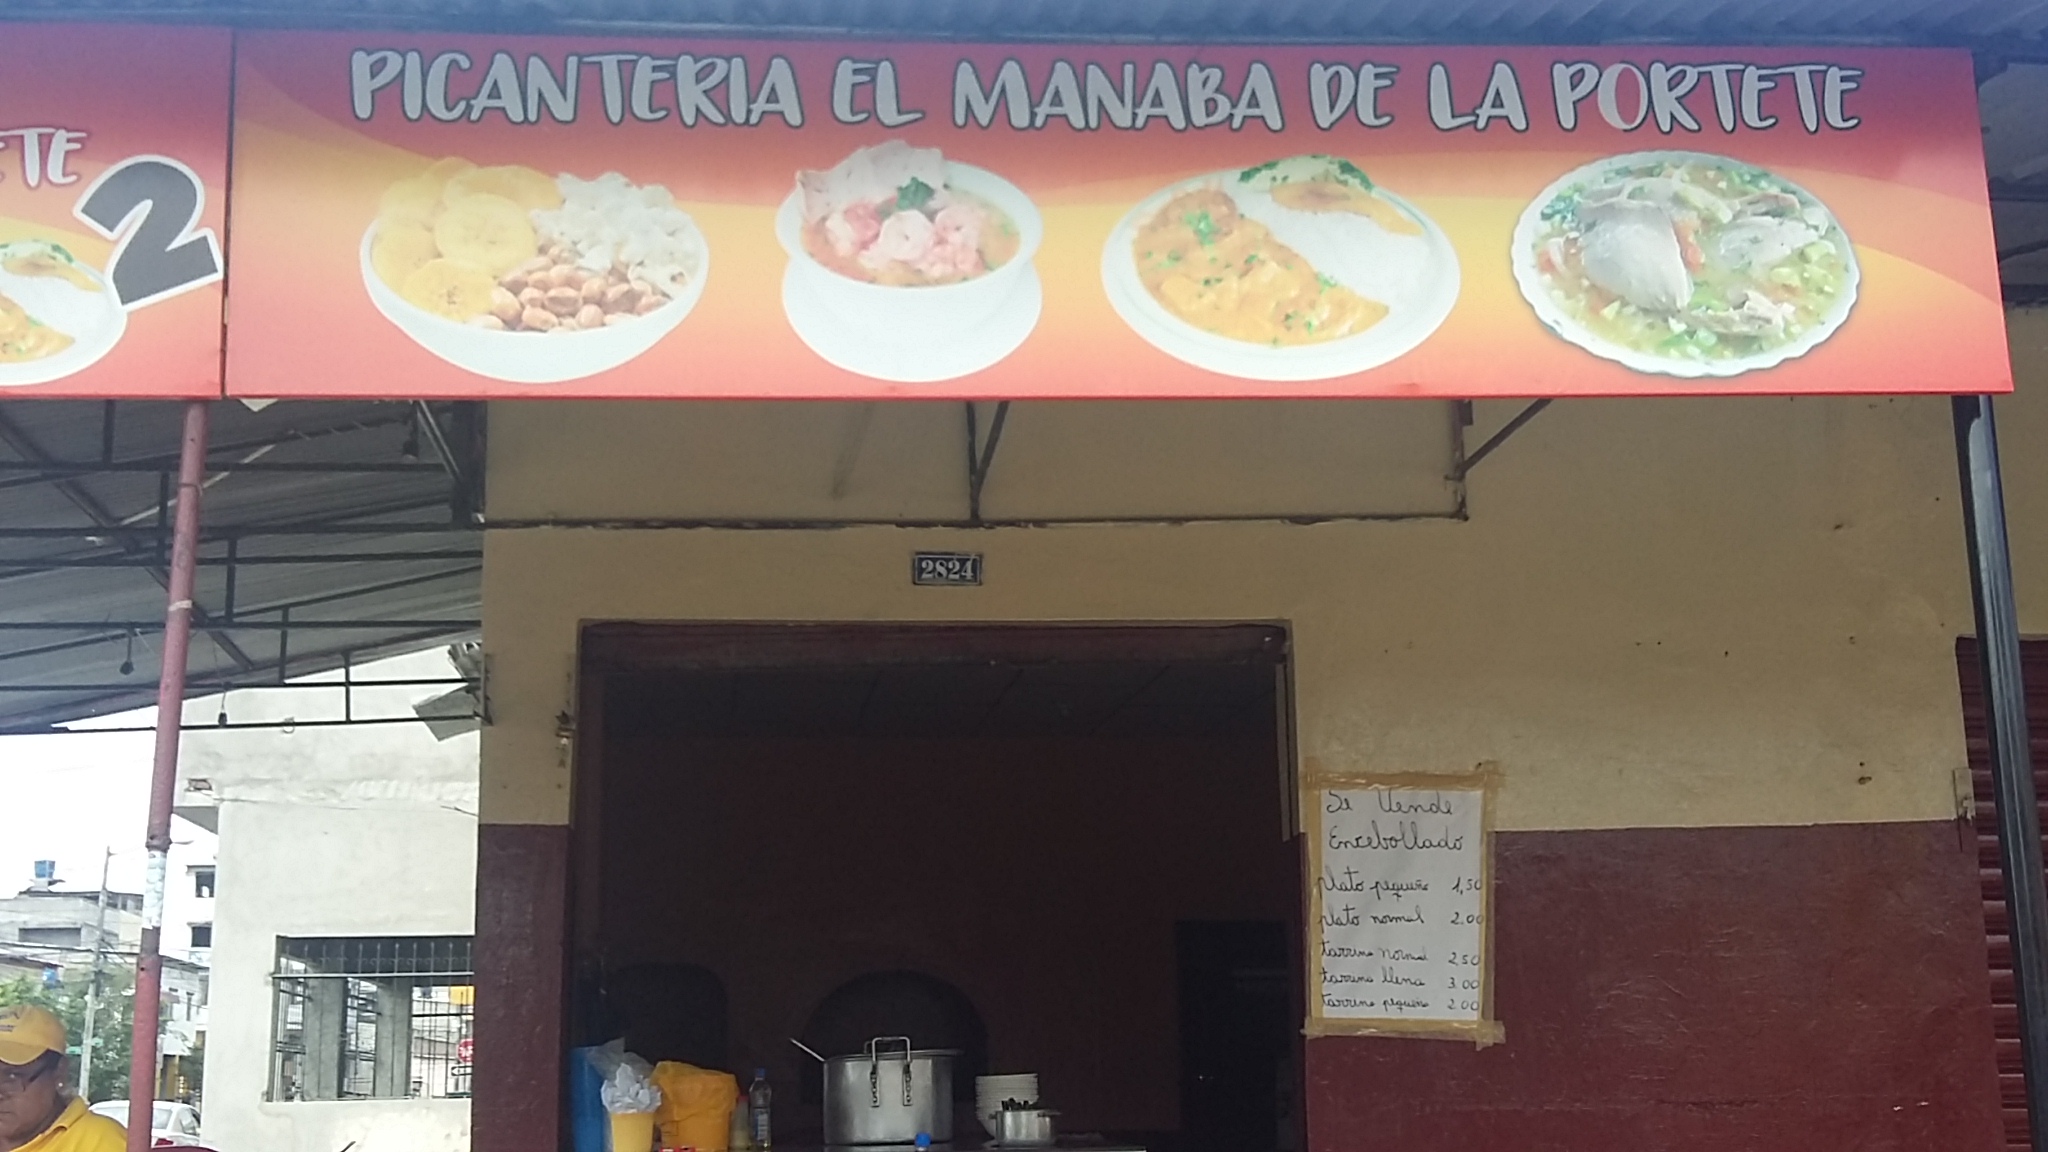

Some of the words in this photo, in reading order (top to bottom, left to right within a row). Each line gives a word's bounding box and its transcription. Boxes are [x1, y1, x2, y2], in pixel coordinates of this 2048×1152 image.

[350, 49, 804, 127] PICANTERIA
[833, 58, 925, 127] EL
[953, 58, 1284, 131] MANABA
[1308, 61, 1399, 130] DE
[1429, 61, 1528, 131] LA
[1551, 60, 1863, 133] PORTETE
[0, 127, 88, 188] TE
[73, 154, 225, 312] 2
[920, 558, 975, 580] 2824
[1326, 789, 1353, 814] Se
[1375, 787, 1453, 815] Vende
[1328, 820, 1464, 850] Encebollado
